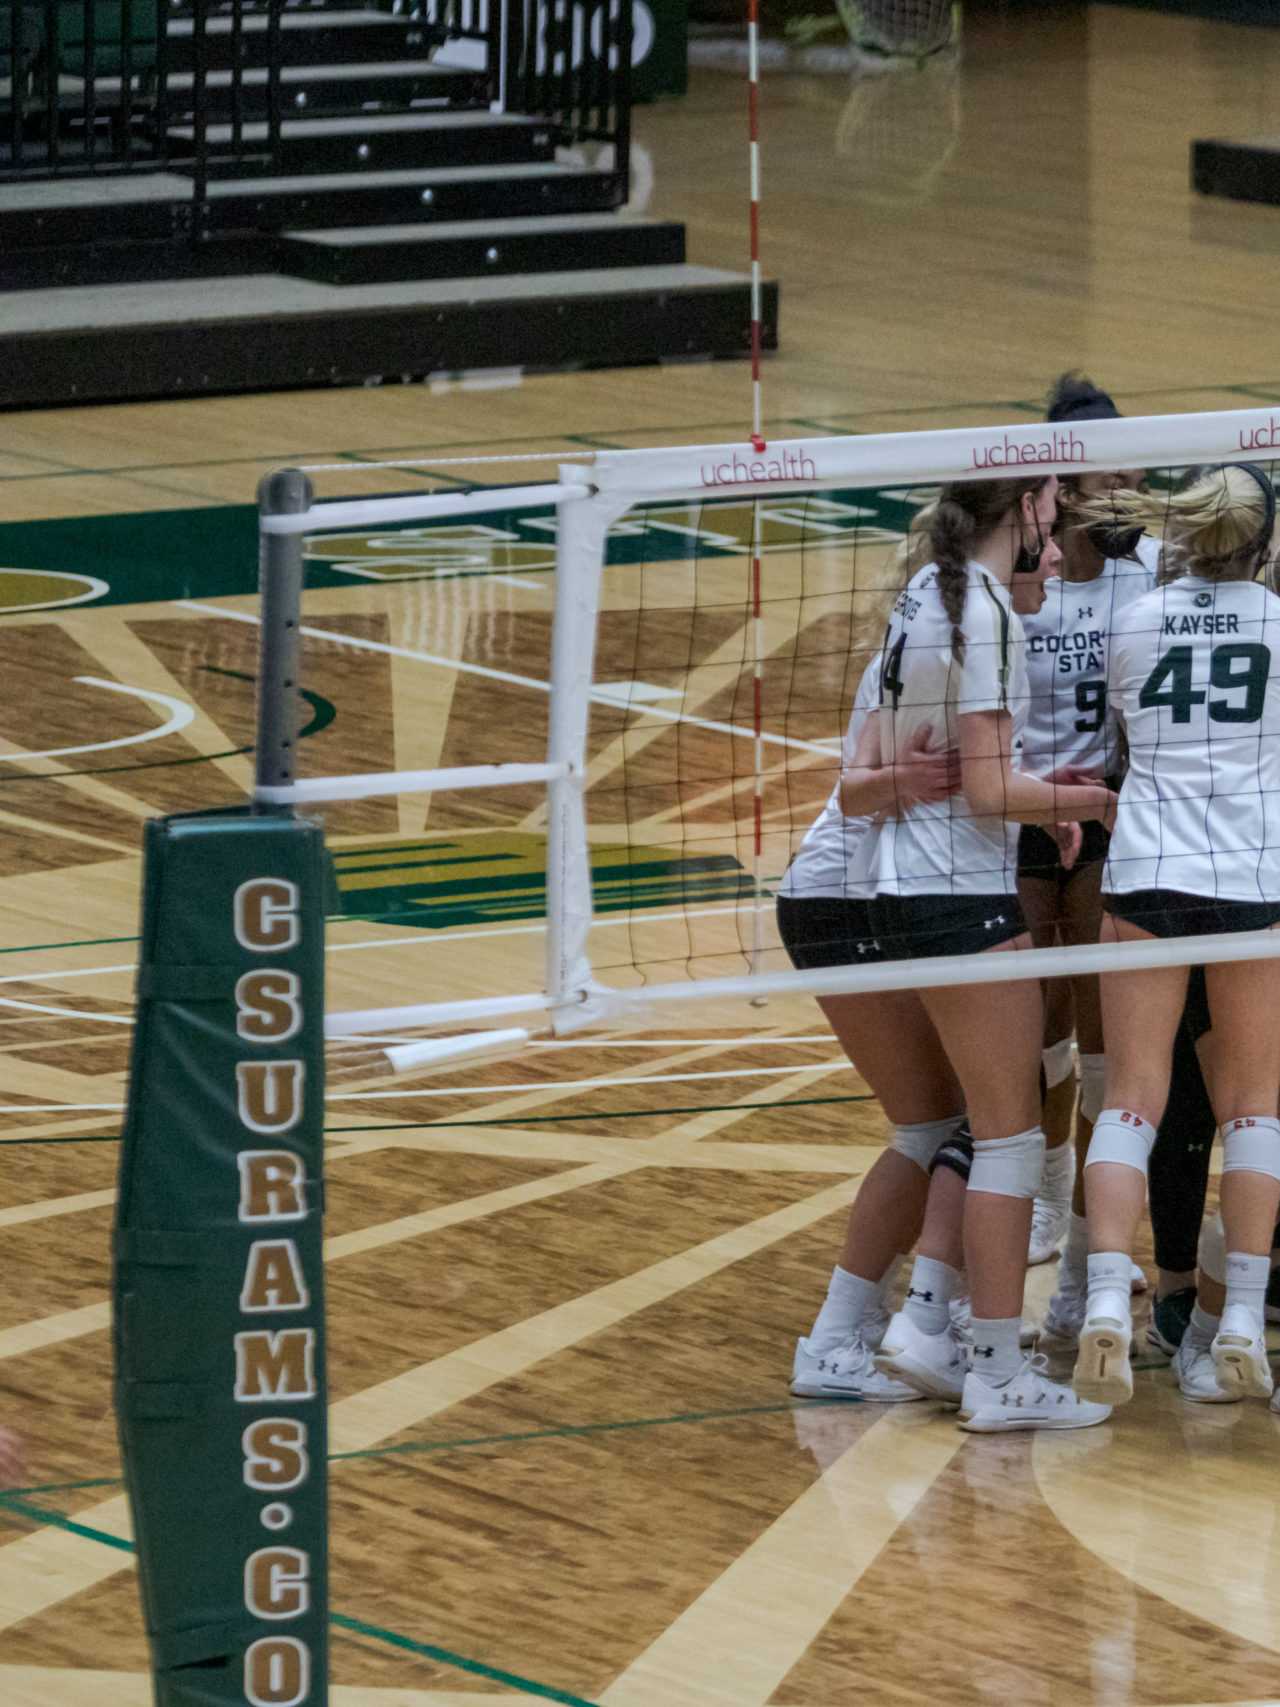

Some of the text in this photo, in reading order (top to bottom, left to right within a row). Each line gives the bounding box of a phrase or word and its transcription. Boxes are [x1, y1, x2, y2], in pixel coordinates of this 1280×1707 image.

[701, 447, 816, 487] uchealth
[972, 430, 1085, 468] uchealth
[1030, 631, 1105, 653] COLOR
[1164, 613, 1239, 635] KAYSER
[1059, 650, 1104, 673] STA
[1138, 643, 1271, 724] 49
[1073, 680, 1107, 733] 9
